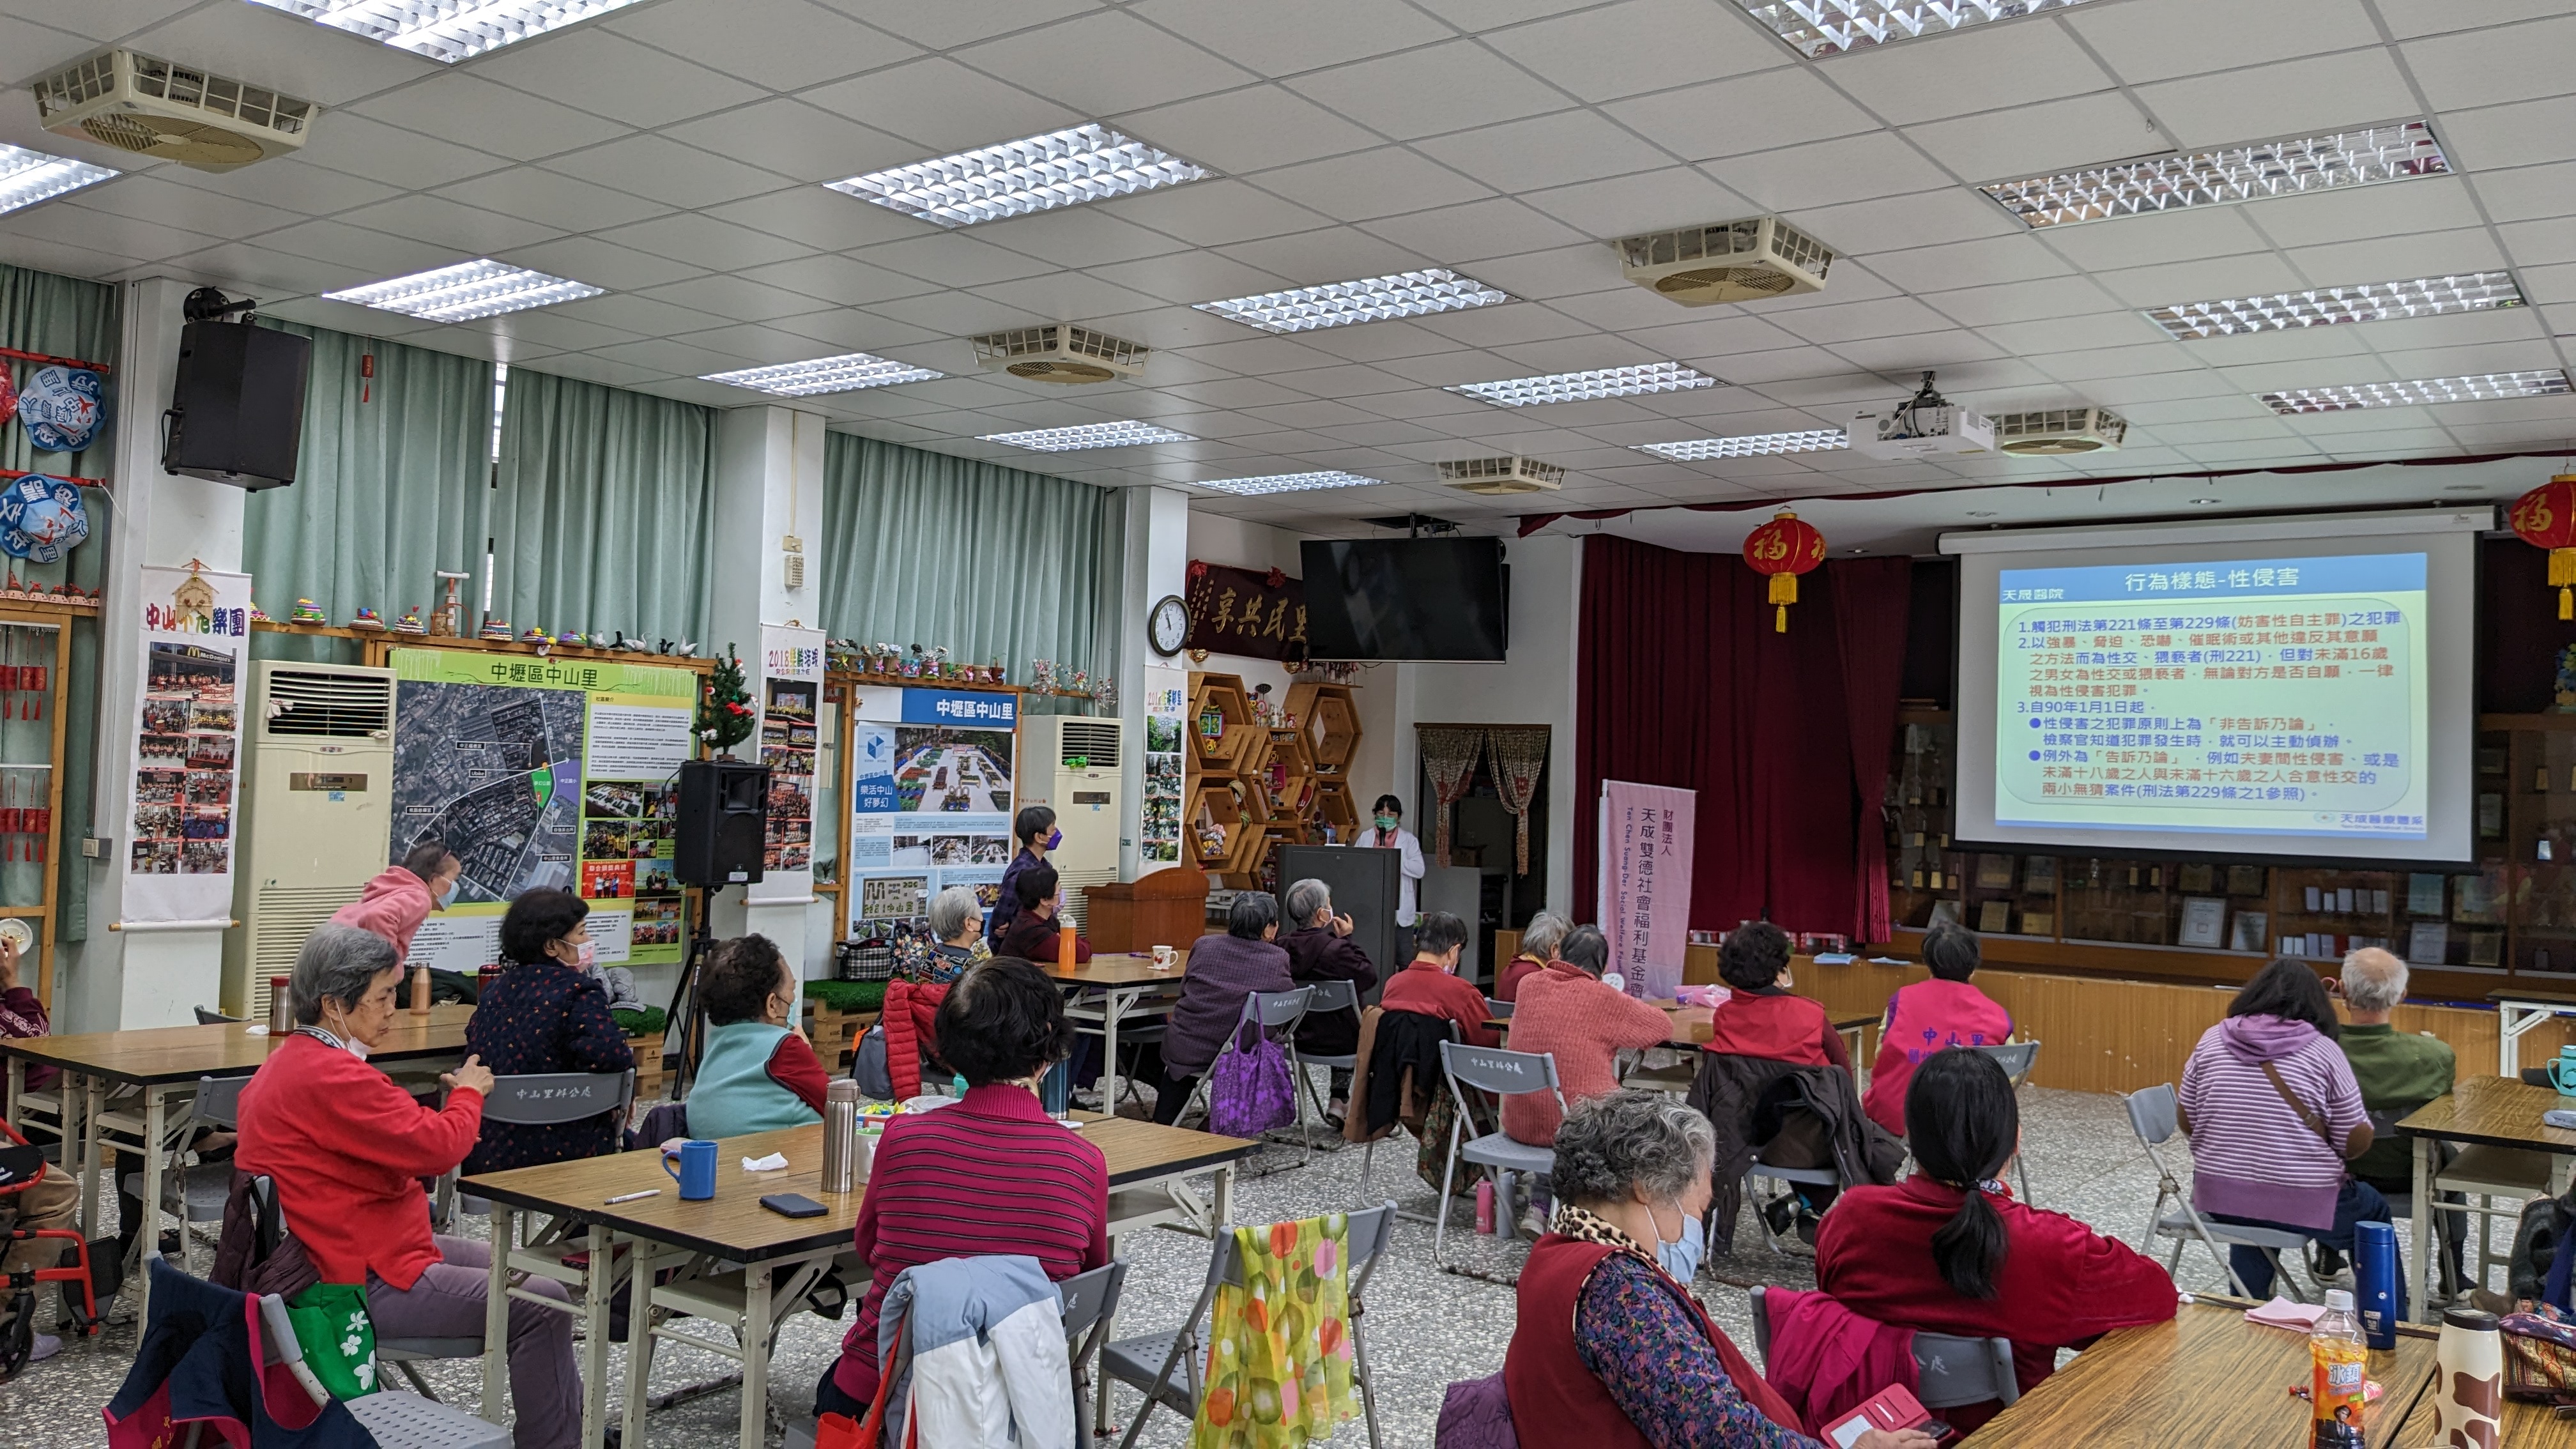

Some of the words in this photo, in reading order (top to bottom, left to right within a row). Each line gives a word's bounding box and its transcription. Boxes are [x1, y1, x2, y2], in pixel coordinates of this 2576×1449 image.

[1753, 528, 1788, 560] 福
[2125, 567, 2299, 592] 行為樣態-性侵害
[2002, 588, 2064, 601] 天晟醫院
[491, 662, 598, 687] 中壢區中山里
[2028, 684, 2149, 697] 視為性侵害犯罪。
[936, 699, 1014, 720] 中壢區中山里
[2042, 766, 2377, 785] 未滿十八歲之人與未滿十六歲之人合意性交的
[859, 785, 893, 796] 樂活中山
[864, 797, 889, 808] 好夢幻
[1660, 809, 1674, 857] 財團法人
[1619, 891, 1628, 914] Social
[1630, 808, 1657, 999] 天成雙德社會福利基金會
[1618, 917, 1626, 947] Welfare
[1922, 1027, 1984, 1046] 中山里
[516, 1085, 592, 1100] 中山里辦公處
